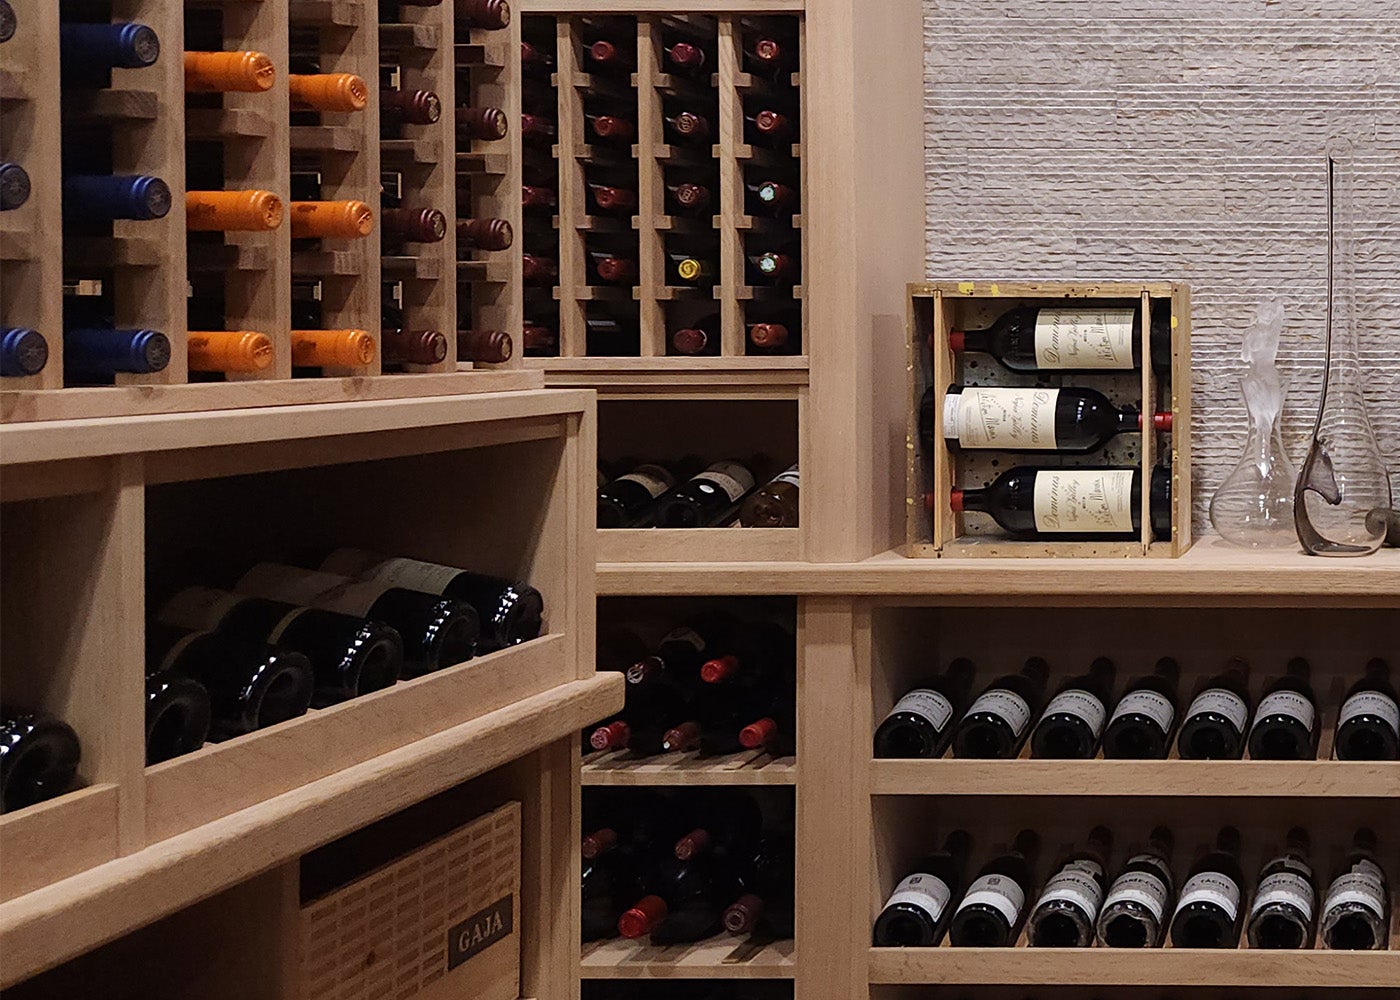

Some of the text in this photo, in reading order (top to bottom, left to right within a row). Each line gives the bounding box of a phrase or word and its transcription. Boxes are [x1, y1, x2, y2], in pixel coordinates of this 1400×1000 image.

[1030, 391, 1049, 444] Dominus
[1042, 475, 1060, 529] Dominus
[458, 911, 504, 952] GAJA
